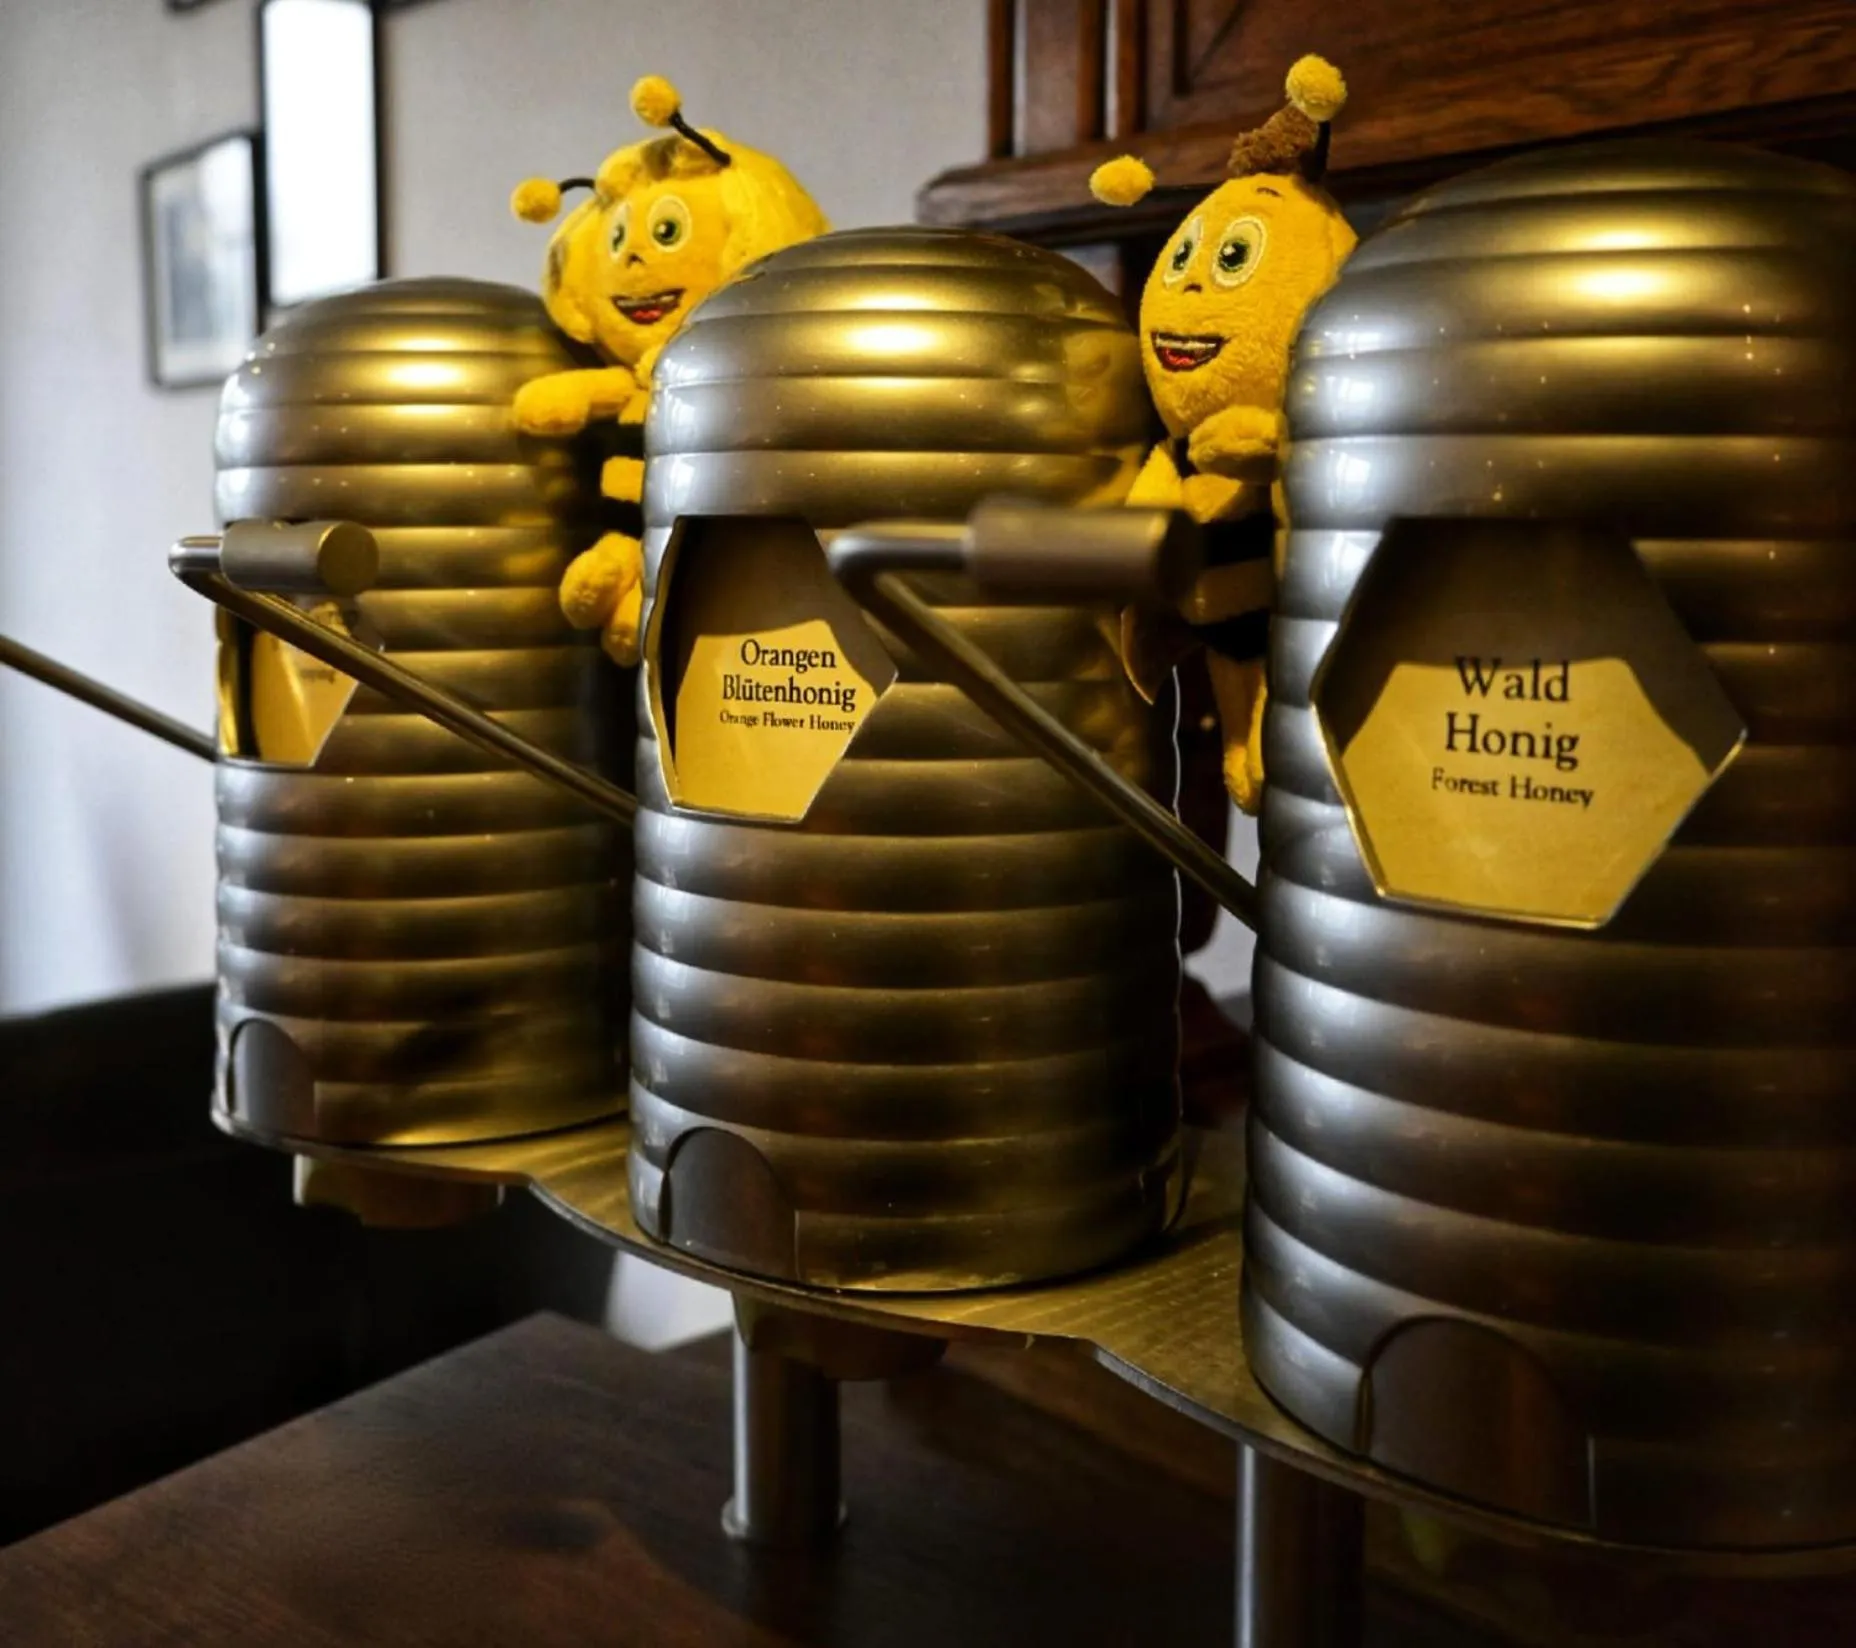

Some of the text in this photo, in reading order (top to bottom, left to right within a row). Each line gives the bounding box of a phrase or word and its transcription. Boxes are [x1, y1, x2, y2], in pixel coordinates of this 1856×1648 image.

[741, 638, 836, 674] Orangen
[722, 674, 856, 712] Blütenhonig
[1455, 656, 1570, 702] Wald
[719, 709, 855, 735] Orange Flower Honey
[1445, 711, 1580, 772] Honig
[1431, 766, 1595, 812] Forest Honey
